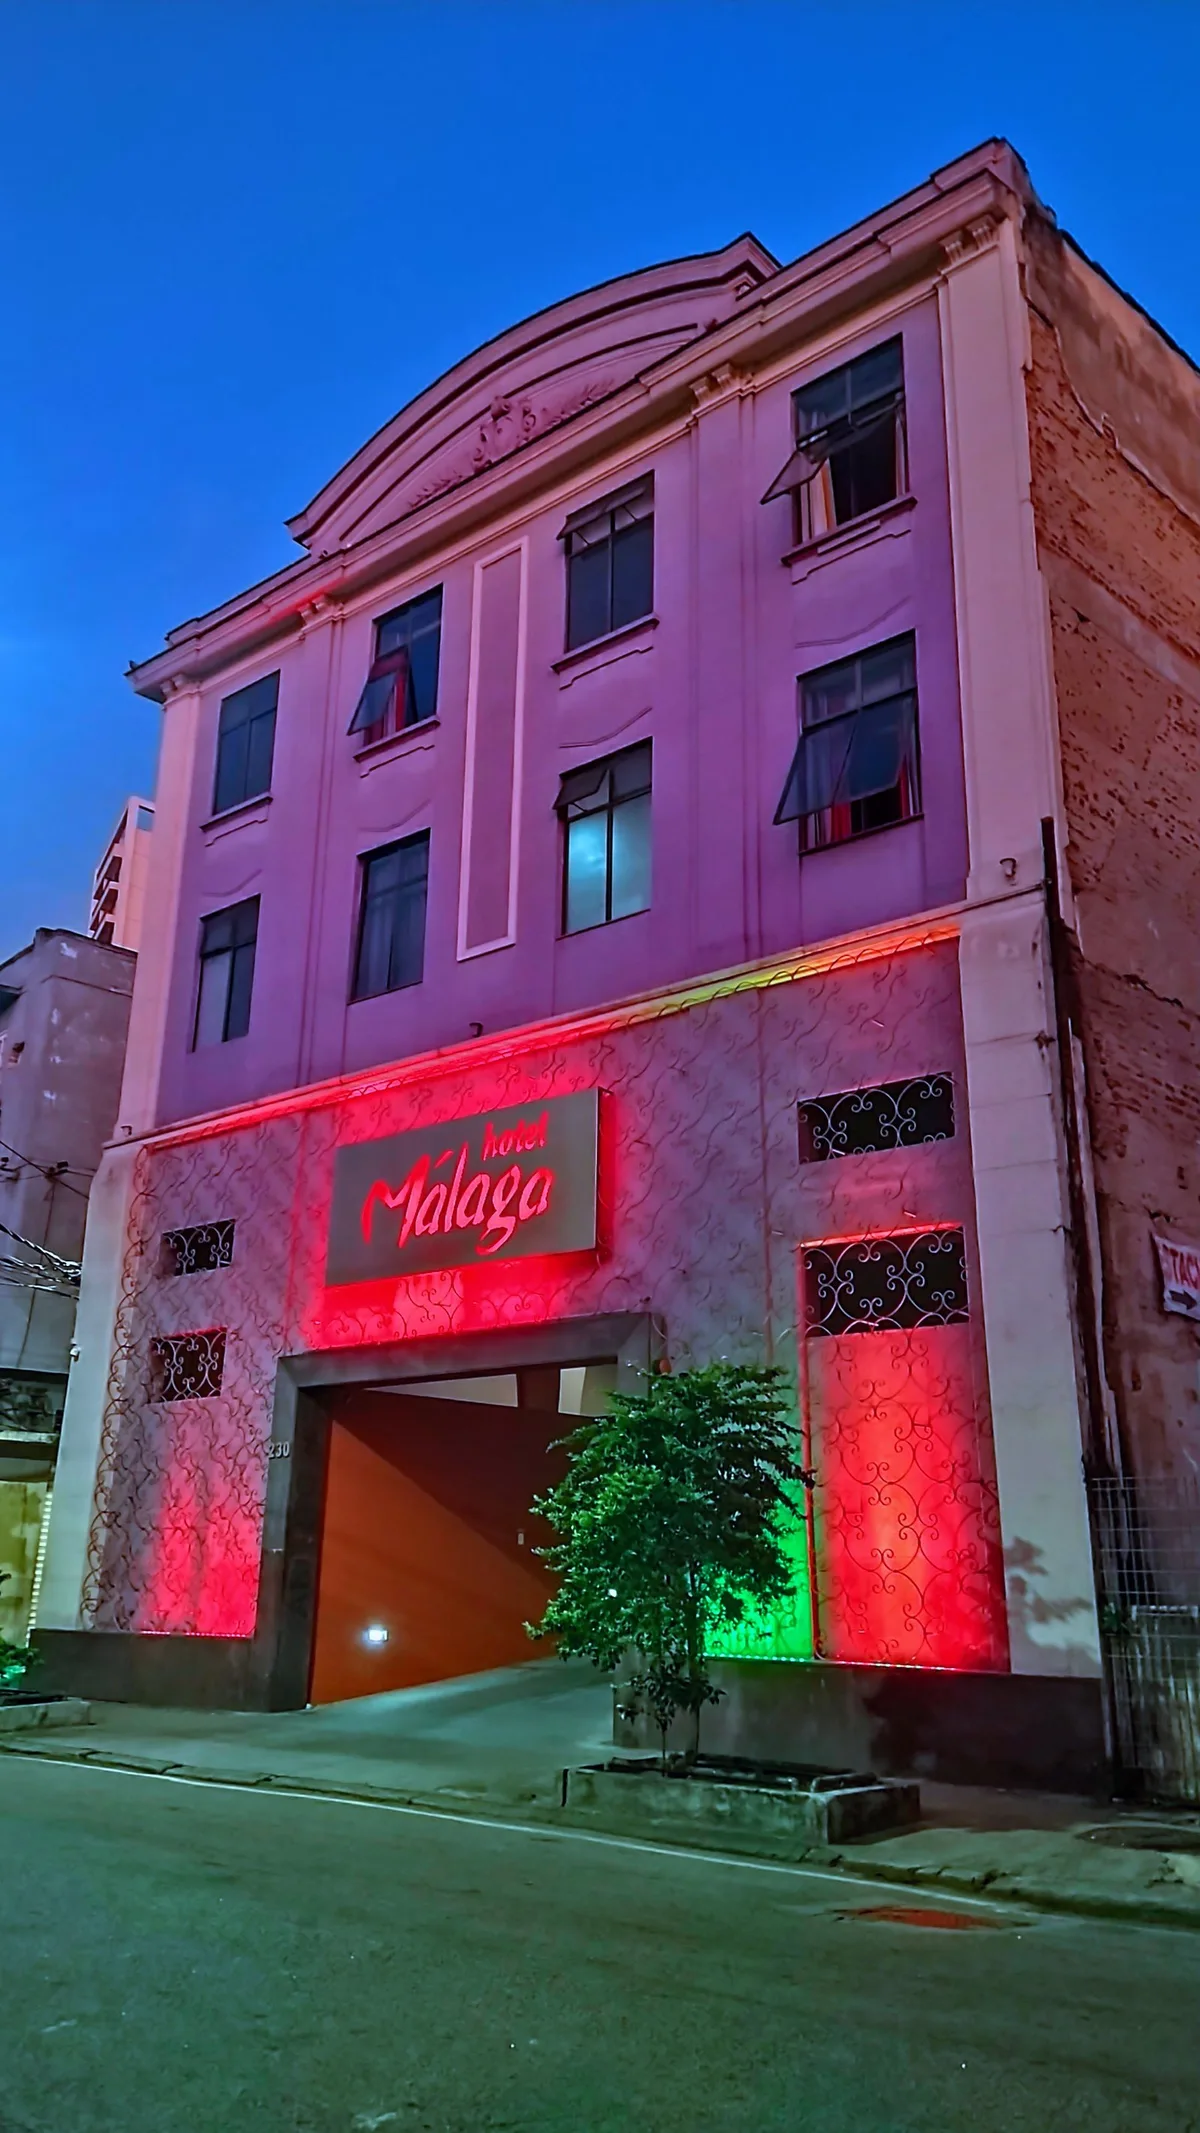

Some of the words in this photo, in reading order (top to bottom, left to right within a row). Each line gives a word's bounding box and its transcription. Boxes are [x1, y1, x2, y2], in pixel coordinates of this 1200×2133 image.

[482, 1109, 549, 1161] hotel
[360, 1141, 554, 1256] Málaga
[268, 1441, 290, 1459] 230
